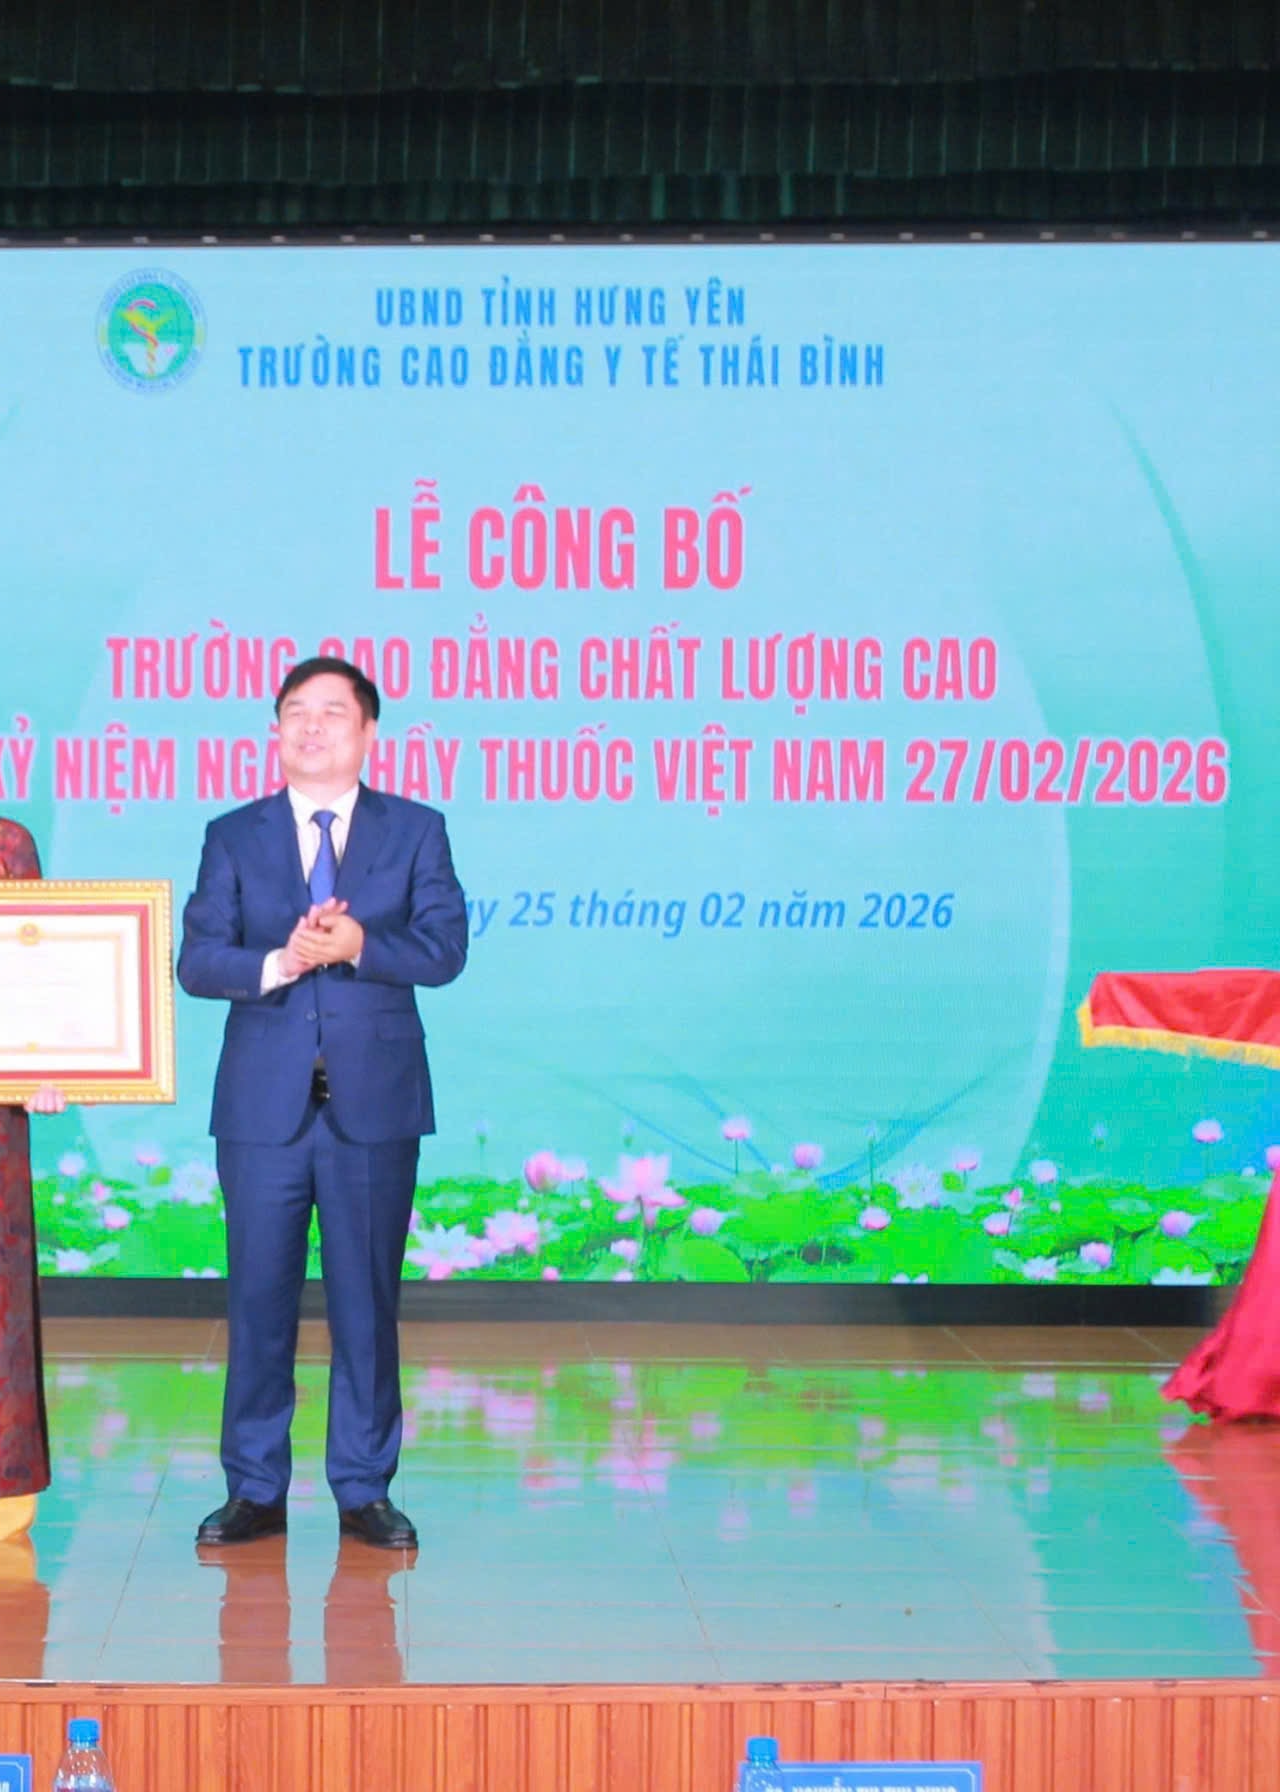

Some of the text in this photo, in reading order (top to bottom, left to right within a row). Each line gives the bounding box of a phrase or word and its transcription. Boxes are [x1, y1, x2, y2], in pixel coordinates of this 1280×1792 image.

[376, 275, 745, 327] UBND TỈNH HƯNG YÊN
[237, 329, 884, 388] TRƯỜNG CAO ĐẲNG Y TẾ THÁI BÌNH
[375, 478, 752, 591] LỄ CÔNG BỐ
[431, 612, 559, 700] ĐẲNG
[580, 621, 701, 700] CHẤT
[722, 632, 883, 716] LƯỢNG
[903, 636, 997, 700] CAO
[55, 723, 175, 814] NIỆM
[480, 722, 633, 801] THUỐC
[654, 723, 754, 816] VIỆT
[773, 738, 885, 801] NAM
[905, 738, 1227, 803] 27/02/2026
[508, 891, 556, 928] 25
[569, 889, 687, 938] tháng
[699, 892, 746, 928] 02
[758, 889, 847, 928] năm
[858, 892, 956, 929] 2026
